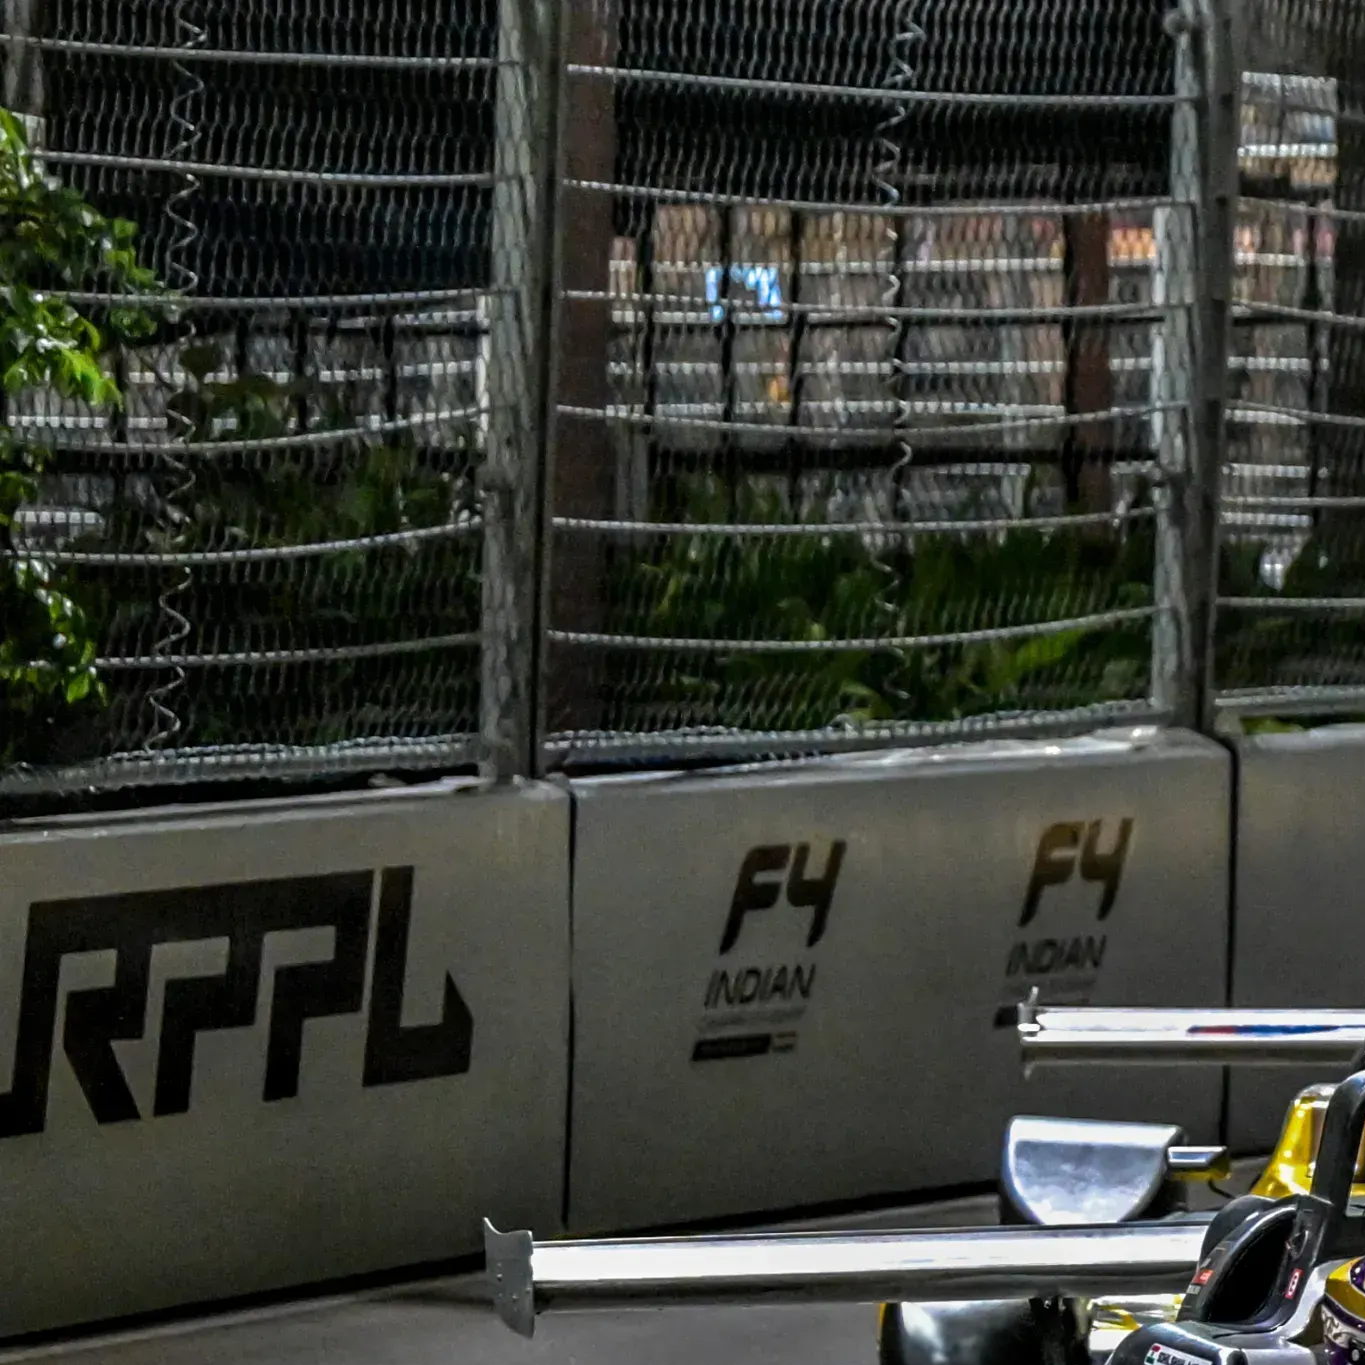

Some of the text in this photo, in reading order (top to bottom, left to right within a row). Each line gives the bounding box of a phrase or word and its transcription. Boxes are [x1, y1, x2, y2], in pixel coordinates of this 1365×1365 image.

[719, 840, 848, 955] F4
[1017, 817, 1135, 928] F4
[0, 865, 474, 1138] RPPL
[703, 962, 817, 1009] INDIAN
